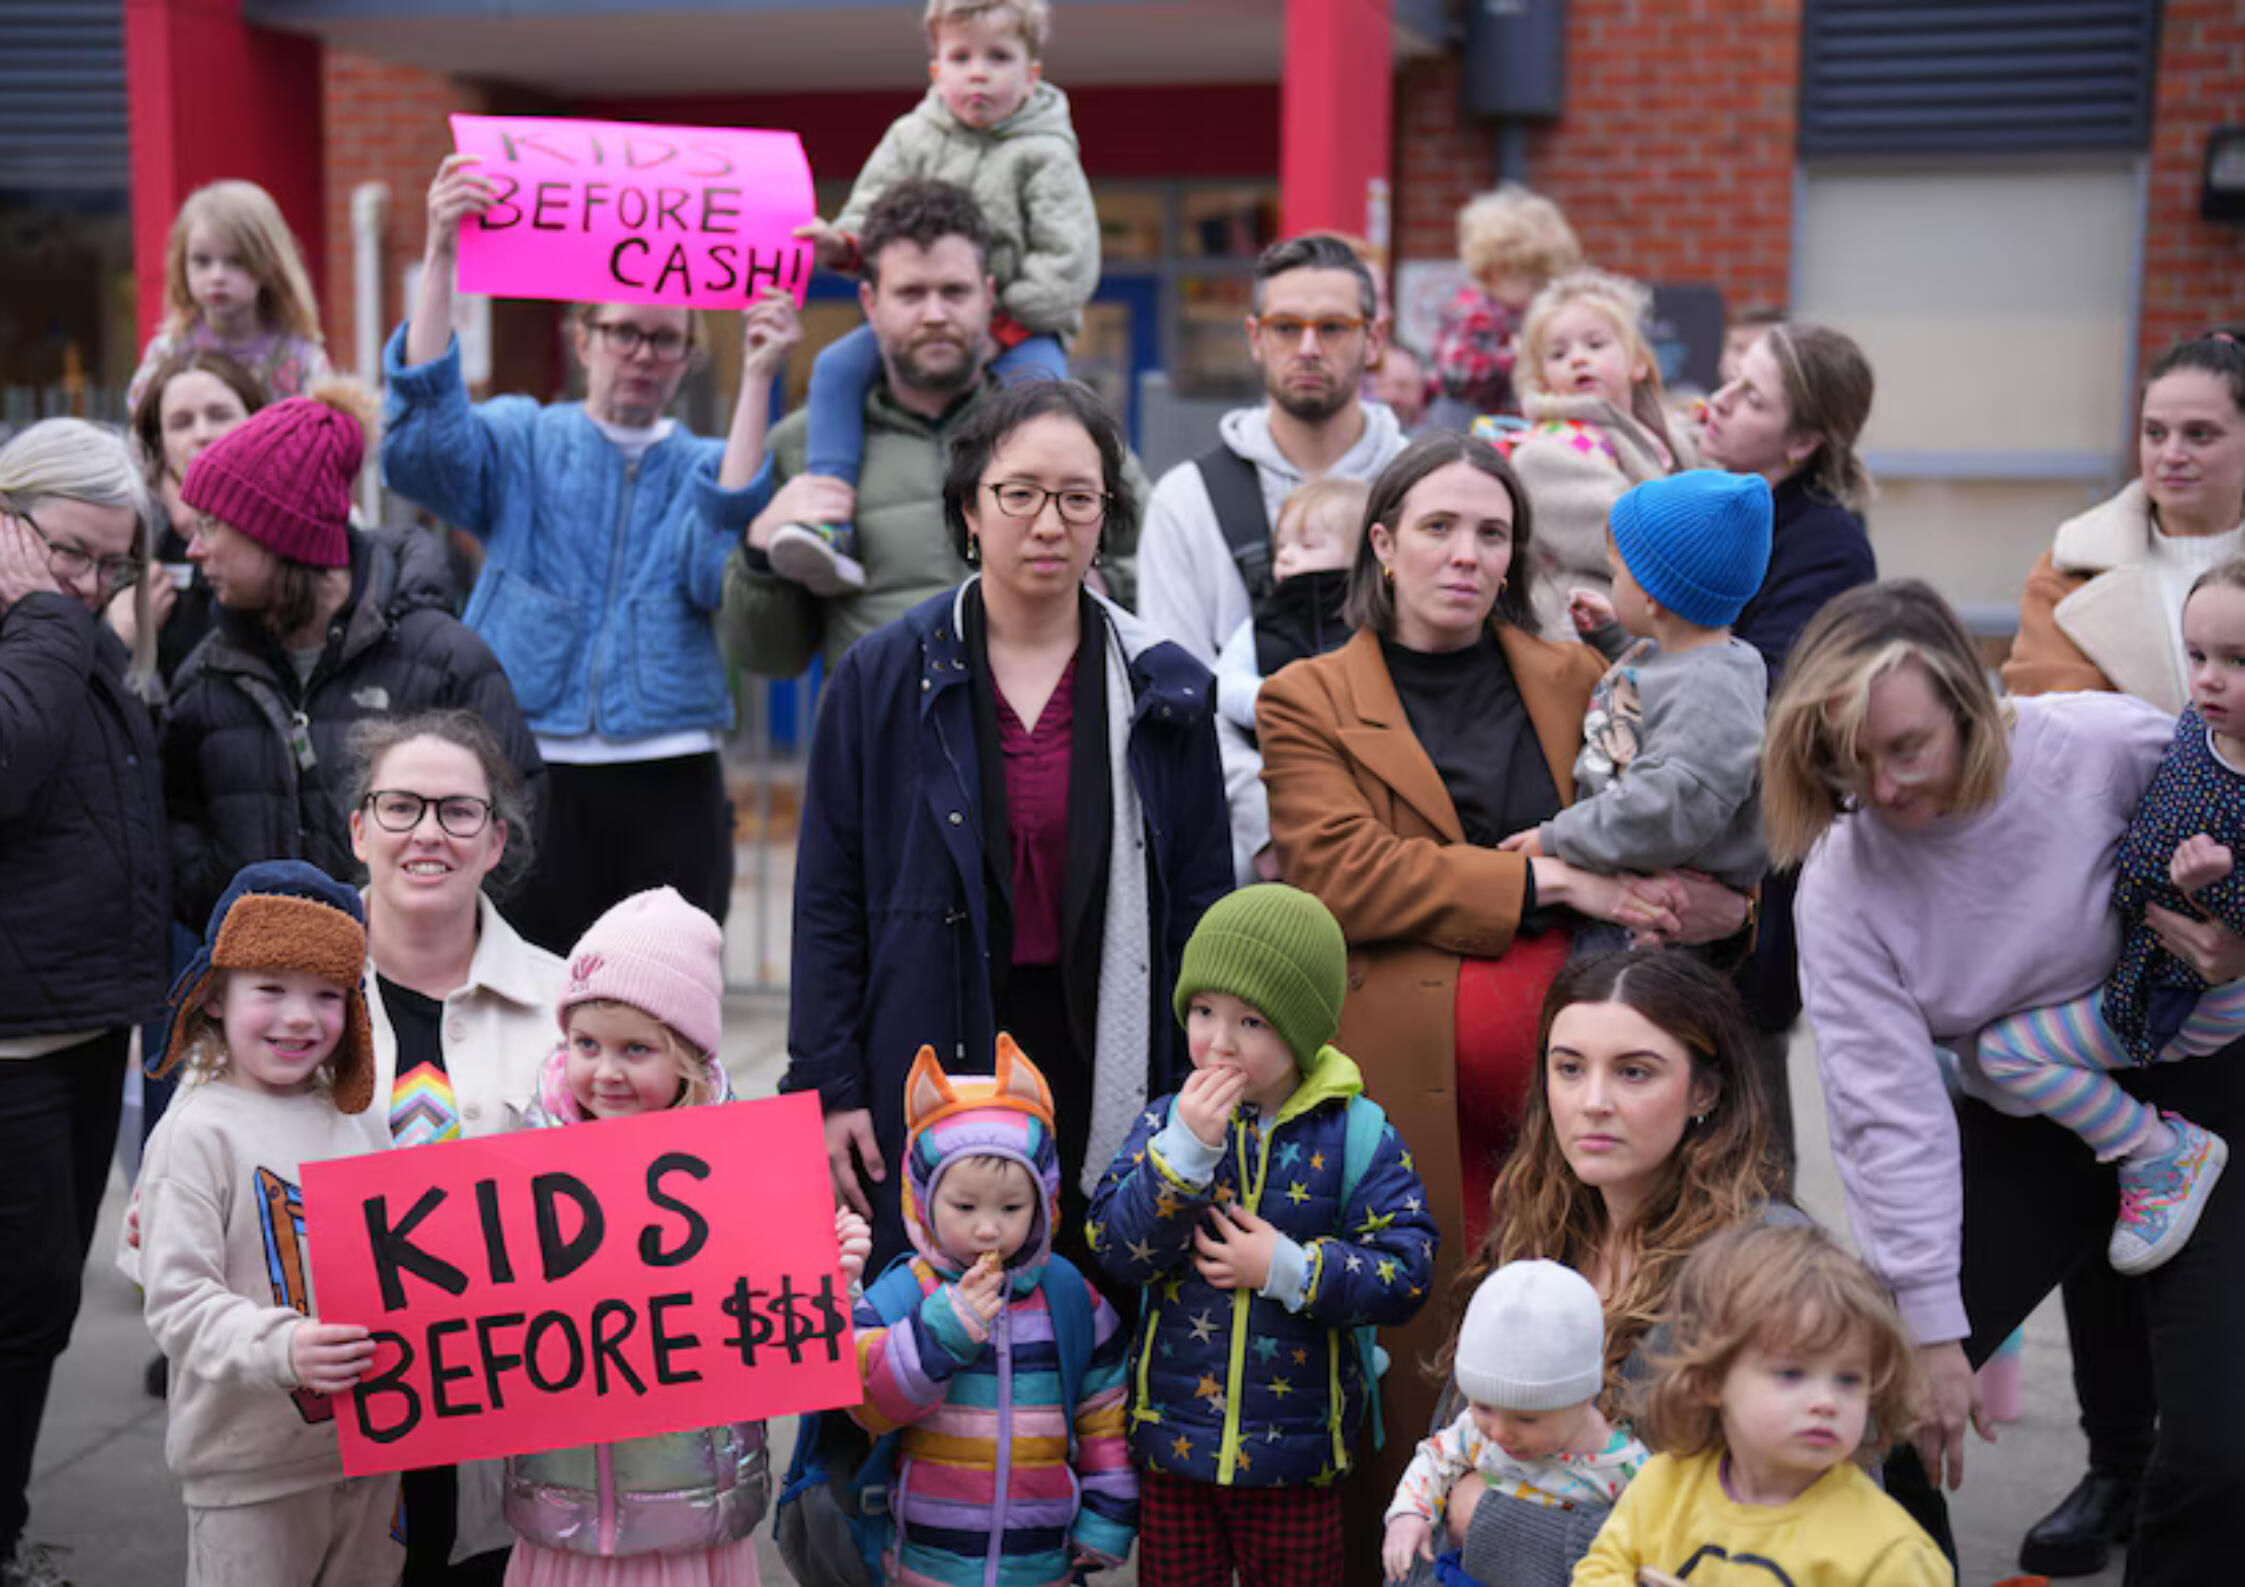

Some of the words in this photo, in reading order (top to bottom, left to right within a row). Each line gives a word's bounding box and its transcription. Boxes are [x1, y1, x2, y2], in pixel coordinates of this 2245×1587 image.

[479, 175, 742, 233] BEFORE
[501, 132, 733, 177] KIDS
[361, 1151, 711, 1312] KIDS
[352, 1291, 703, 1444] BEFORE
[721, 1273, 847, 1366] $$$
